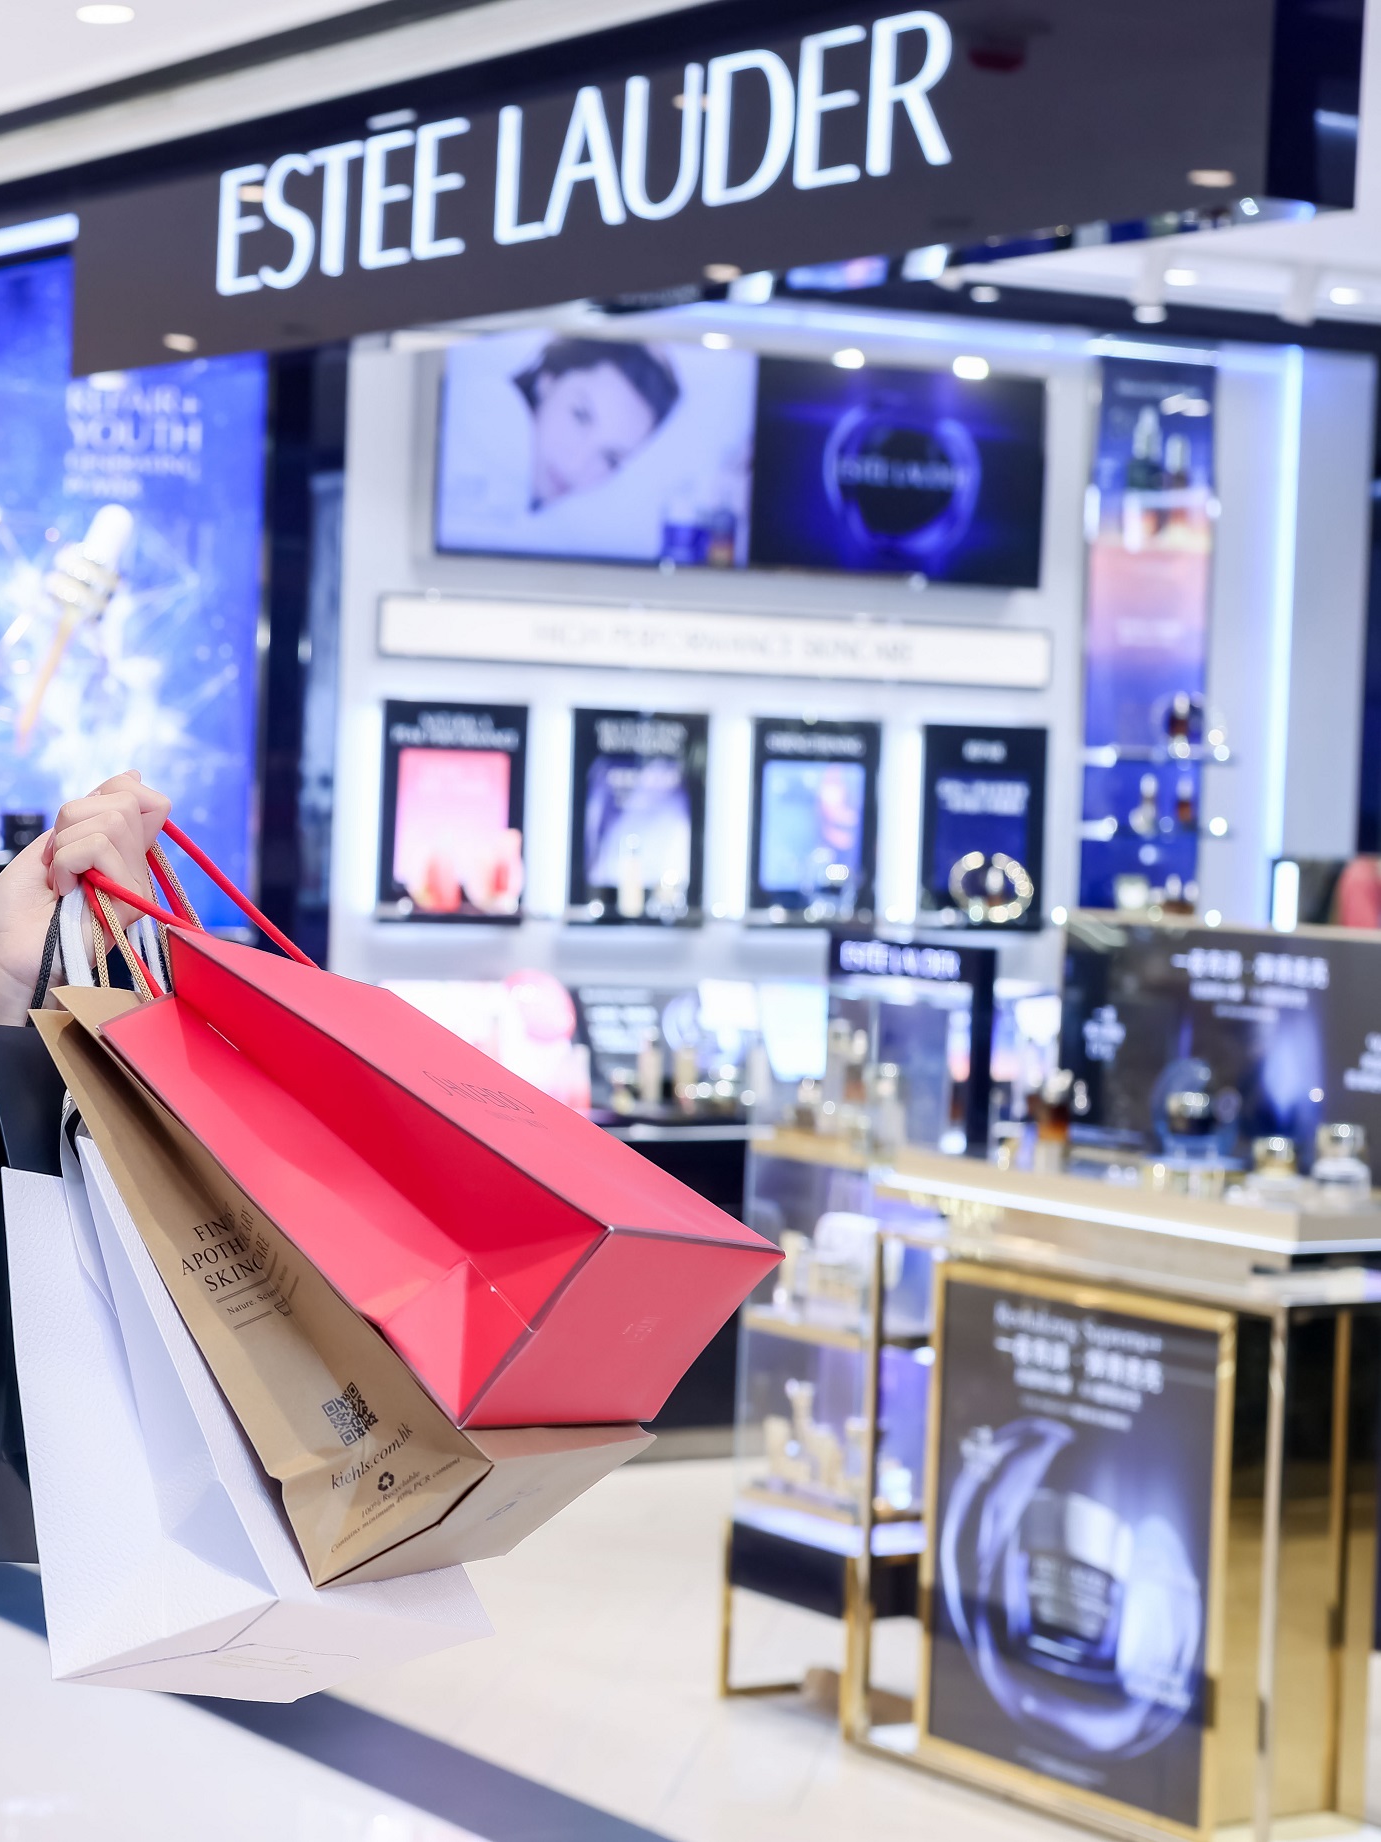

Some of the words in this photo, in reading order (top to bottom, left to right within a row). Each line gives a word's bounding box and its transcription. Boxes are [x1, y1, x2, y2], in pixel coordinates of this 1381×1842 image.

[494, 10, 952, 245] LAUDER
[204, 1231, 270, 1292] SKINCARE
[226, 1299, 257, 1316] Nature.
[331, 1422, 413, 1490] kiehls.com.hk
